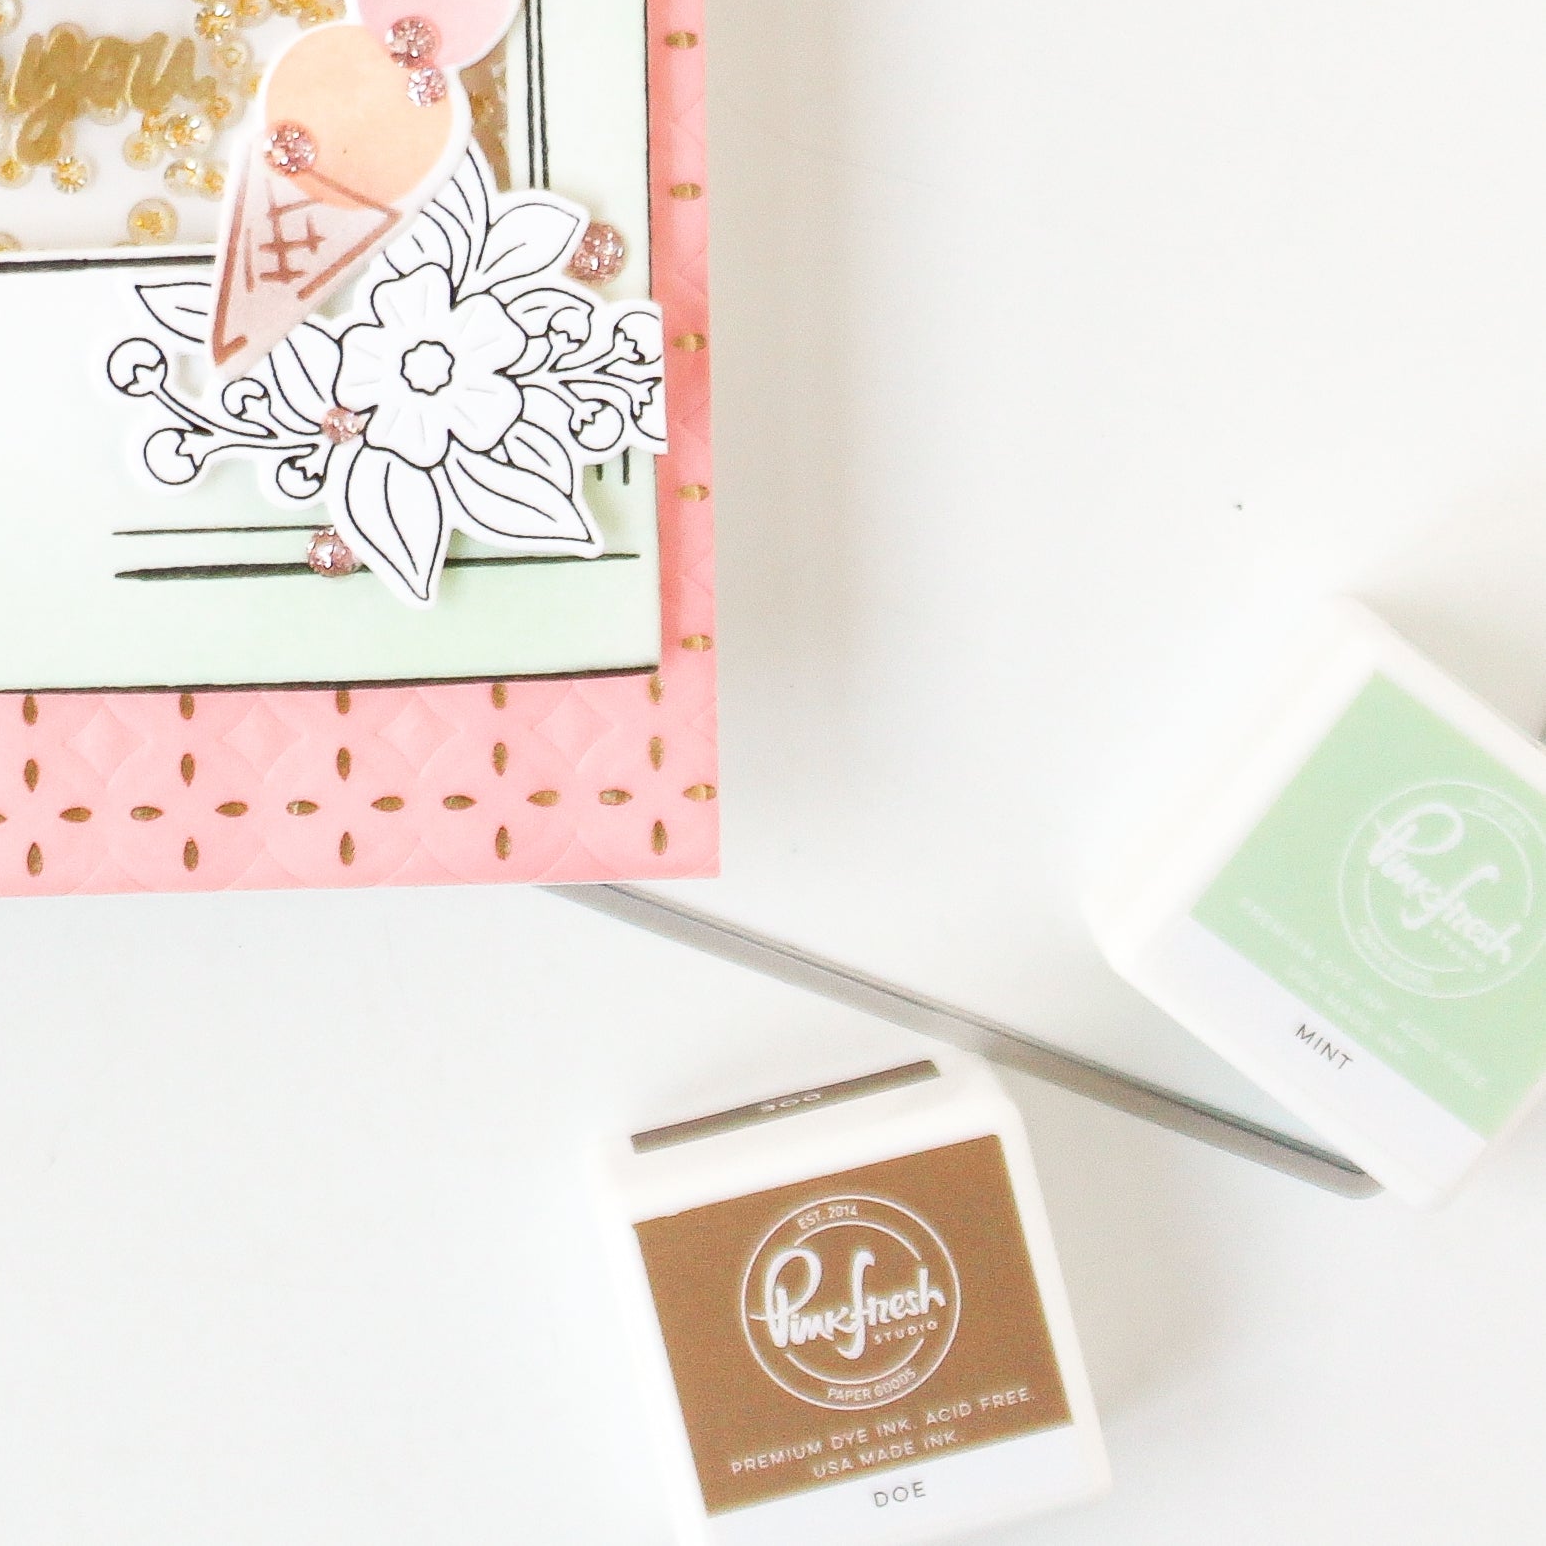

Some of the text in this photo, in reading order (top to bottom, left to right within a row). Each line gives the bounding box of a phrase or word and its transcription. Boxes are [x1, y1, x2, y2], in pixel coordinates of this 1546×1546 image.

[7, 29, 215, 164] you
[1295, 1023, 1353, 1070] MINT
[828, 1205, 859, 1219] 2014
[874, 1320, 938, 1345] STUDIO
[827, 1368, 917, 1401] PAPER GOODS
[730, 1387, 1035, 1476] PREMIUM DYE INK. ACID FREE.
[812, 1430, 963, 1478] USA MADE INK.
[873, 1480, 926, 1507] DOE
